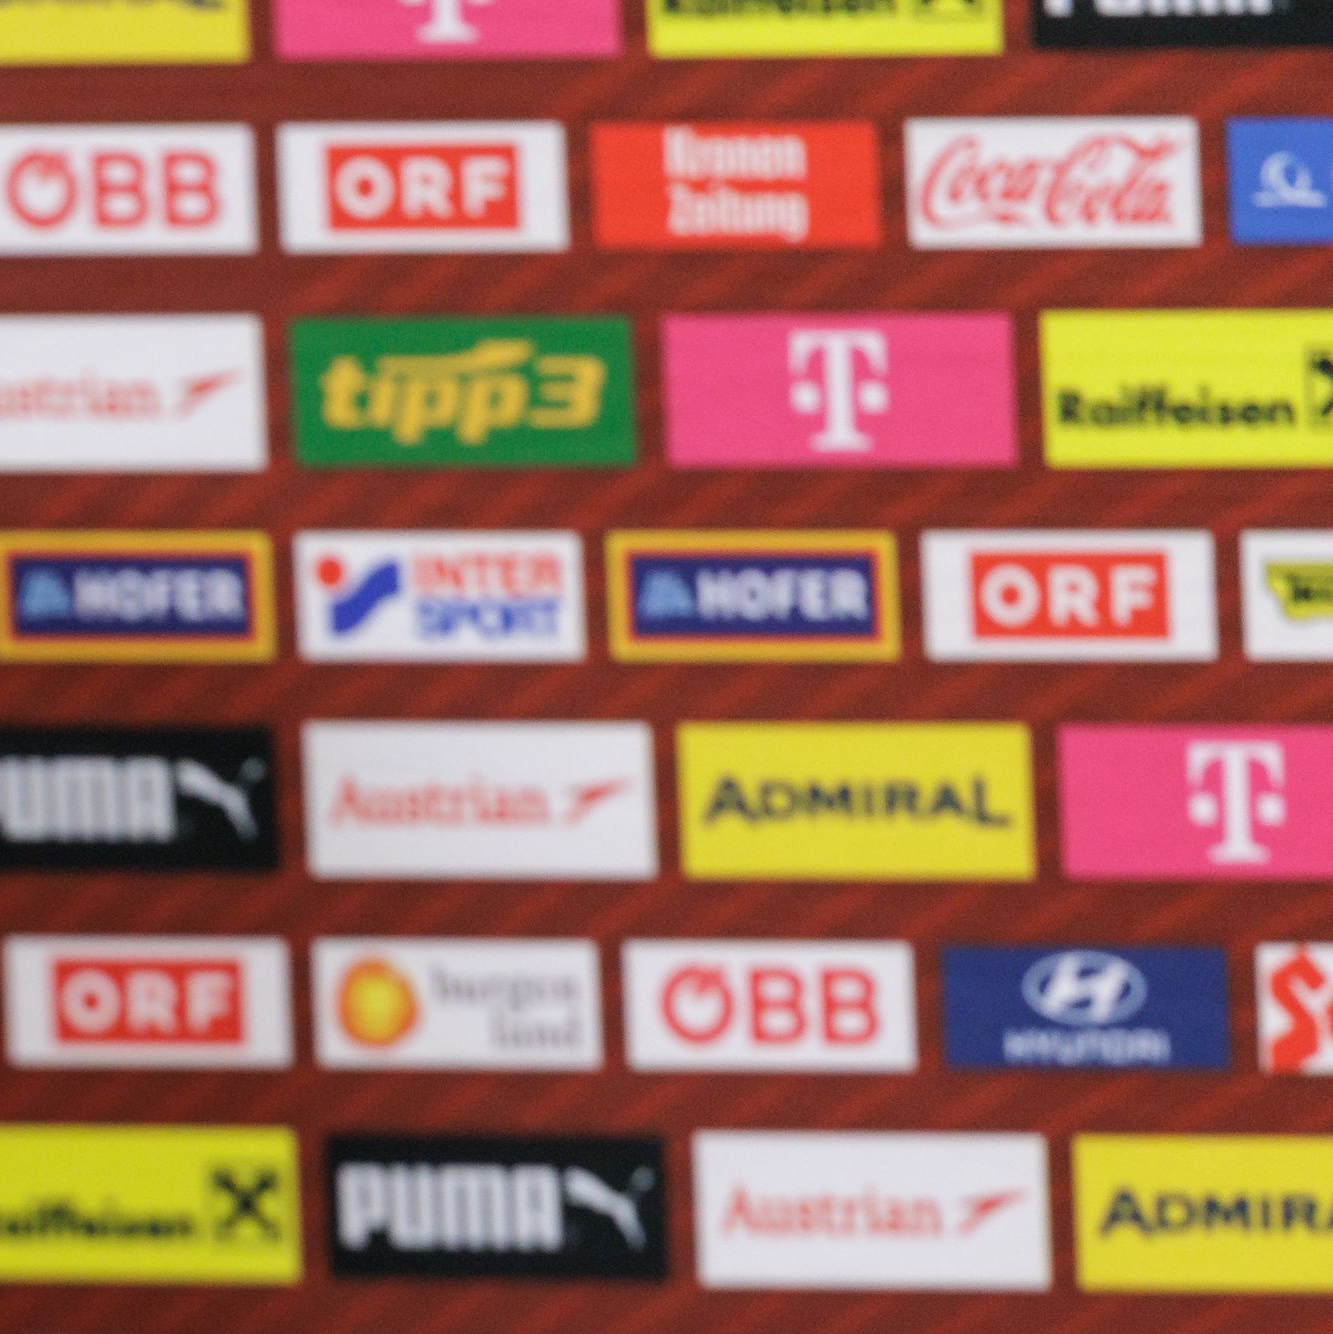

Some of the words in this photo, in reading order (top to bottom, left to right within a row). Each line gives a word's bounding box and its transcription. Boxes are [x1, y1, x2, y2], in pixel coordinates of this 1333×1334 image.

[334, 155, 510, 219] ORF
[920, 134, 1180, 230] Coca-Cola
[322, 340, 605, 444] tipp3
[1056, 386, 1296, 428] Raiffeisen
[72, 569, 243, 620] HOFER
[414, 553, 561, 592] INTER
[696, 569, 867, 620] HOFER
[980, 565, 1156, 627] ORF
[416, 597, 559, 638] SPORT
[328, 776, 550, 828] Austrian
[703, 775, 1011, 828] ADMIRAL
[60, 968, 235, 1034] ORF
[337, 1163, 567, 1251] PUMA
[721, 1186, 943, 1238] Austrian
